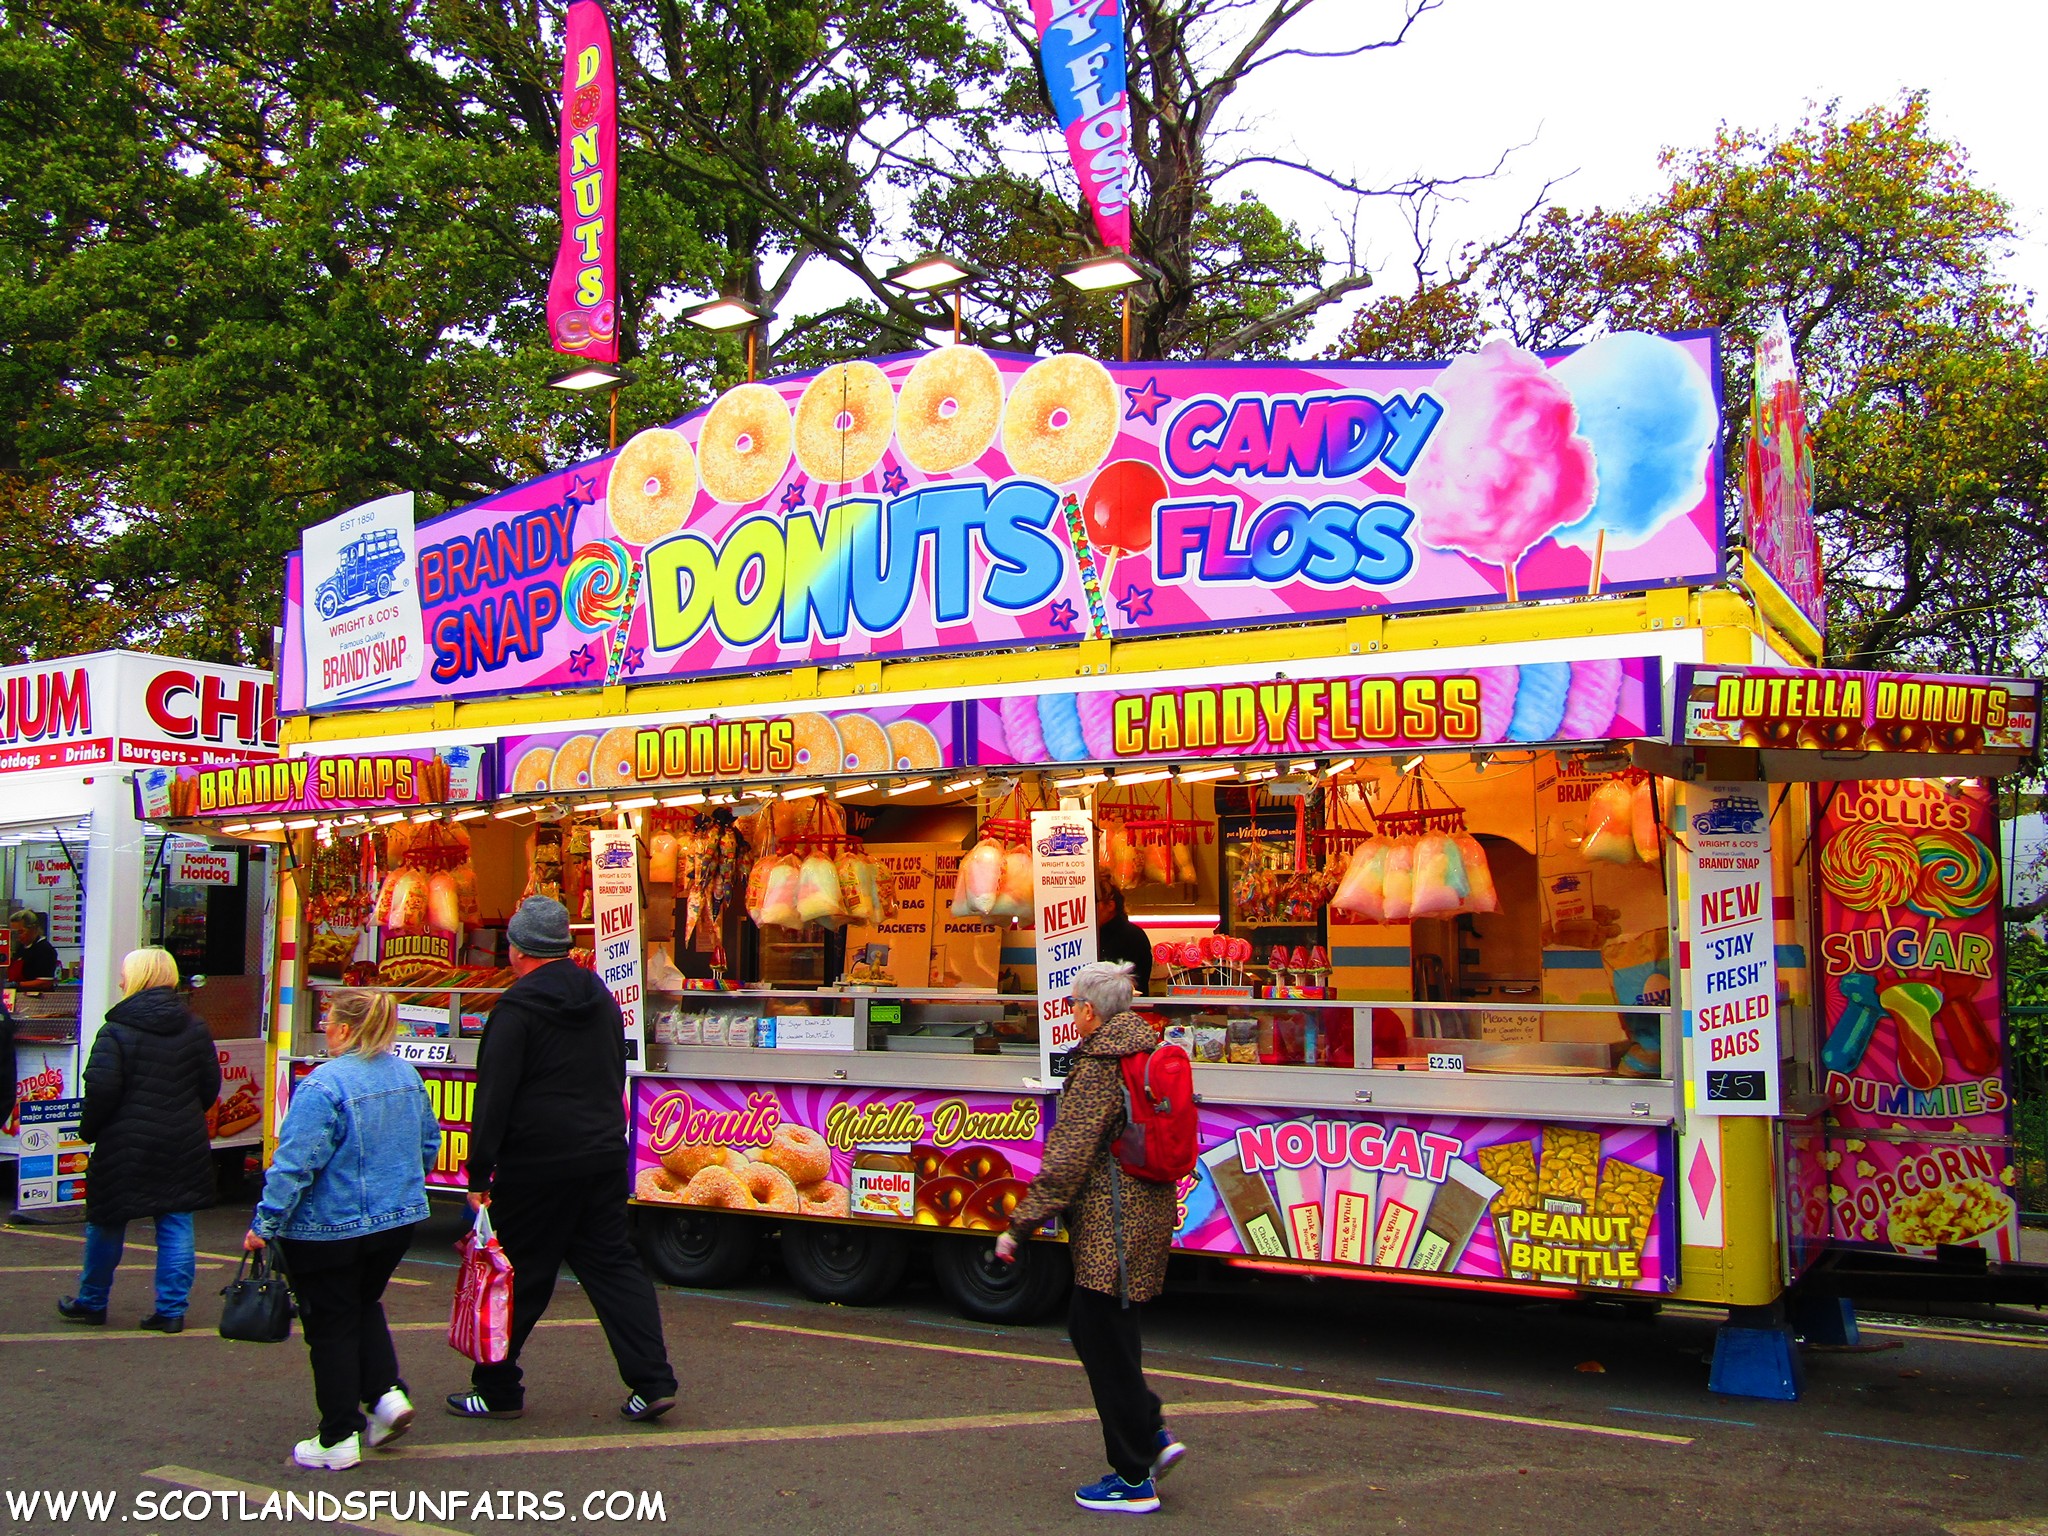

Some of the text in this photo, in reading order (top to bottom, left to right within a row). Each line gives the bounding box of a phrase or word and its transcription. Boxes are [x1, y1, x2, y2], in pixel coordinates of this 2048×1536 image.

[1064, 43, 1131, 216] FLOSS
[1165, 395, 1445, 479] CANDY
[340, 512, 375, 531] EST 1850
[420, 504, 575, 603] BRANDY
[1157, 500, 1415, 586] FLOSS
[647, 483, 1068, 648] DONUTS
[329, 606, 399, 637] WRIGHT & CO'S
[434, 584, 561, 681] SNAP
[340, 631, 386, 650] Famous Quality
[323, 635, 407, 690] BRANDY SNAP
[1716, 677, 2008, 727] NUTELLA DONUTS
[1114, 678, 1479, 753] CANDYFLOSS
[2008, 714, 2032, 729] ella
[0, 744, 106, 770] otdogs Drinks
[122, 743, 187, 763] Burgers
[637, 719, 794, 782] DONUTS
[199, 761, 308, 810] BRANDY
[320, 757, 413, 800] SNAPS
[1838, 794, 1969, 829] LOLLIES
[185, 853, 227, 867] Footlong
[904, 857, 921, 870] CO'S
[1699, 858, 1760, 869] BRANDY SNAP
[38, 873, 61, 887] Burger
[180, 865, 230, 883] Hotdog
[899, 876, 920, 890] SNAP
[1042, 875, 1086, 885] BRANDY SNAP
[599, 885, 632, 894] BRANDY SNAP
[902, 900, 925, 909] BAG
[1043, 896, 1087, 933] NEW
[1701, 881, 1760, 927] NEW
[600, 903, 633, 936] NEW
[877, 924, 926, 933] PACKETS
[385, 936, 449, 958] HOTDOGS
[1823, 928, 1992, 977] SUGAR
[612, 984, 640, 1005] ALED
[1635, 988, 1670, 1003] SILV
[622, 1009, 635, 1027] GS
[1483, 1012, 1512, 1024] Please
[1517, 1016, 1527, 1025] go
[1698, 994, 1769, 1032] SEALED
[1052, 1022, 1083, 1045] BAG
[405, 1044, 424, 1058] for
[428, 1045, 446, 1060] £5
[1711, 1029, 1760, 1062] BAGS
[1429, 1057, 1462, 1070] £2.50
[1827, 1072, 2006, 1117] DUMMIES
[21, 1113, 43, 1122] major
[45, 1111, 66, 1120] credit
[44, 1103, 69, 1112] accept
[649, 1090, 781, 1154] Donuts
[826, 1099, 1041, 1152] Nutella Donuts
[1236, 1121, 1463, 1184] NOUGAT
[31, 1188, 49, 1201] Pay
[859, 1175, 910, 1192] nutella
[1836, 1146, 1993, 1237] POPCORN
[1305, 1209, 1315, 1230] Pink
[1343, 1198, 1352, 1226] White
[1375, 1244, 1388, 1265] Pink
[1386, 1208, 1401, 1233] White
[1511, 1209, 1631, 1242] PEANUT
[1270, 1235, 1280, 1252] Milk
[1340, 1237, 1349, 1259] Pink
[1413, 1252, 1425, 1267] Milk
[1511, 1242, 1639, 1277] BRITTLE
